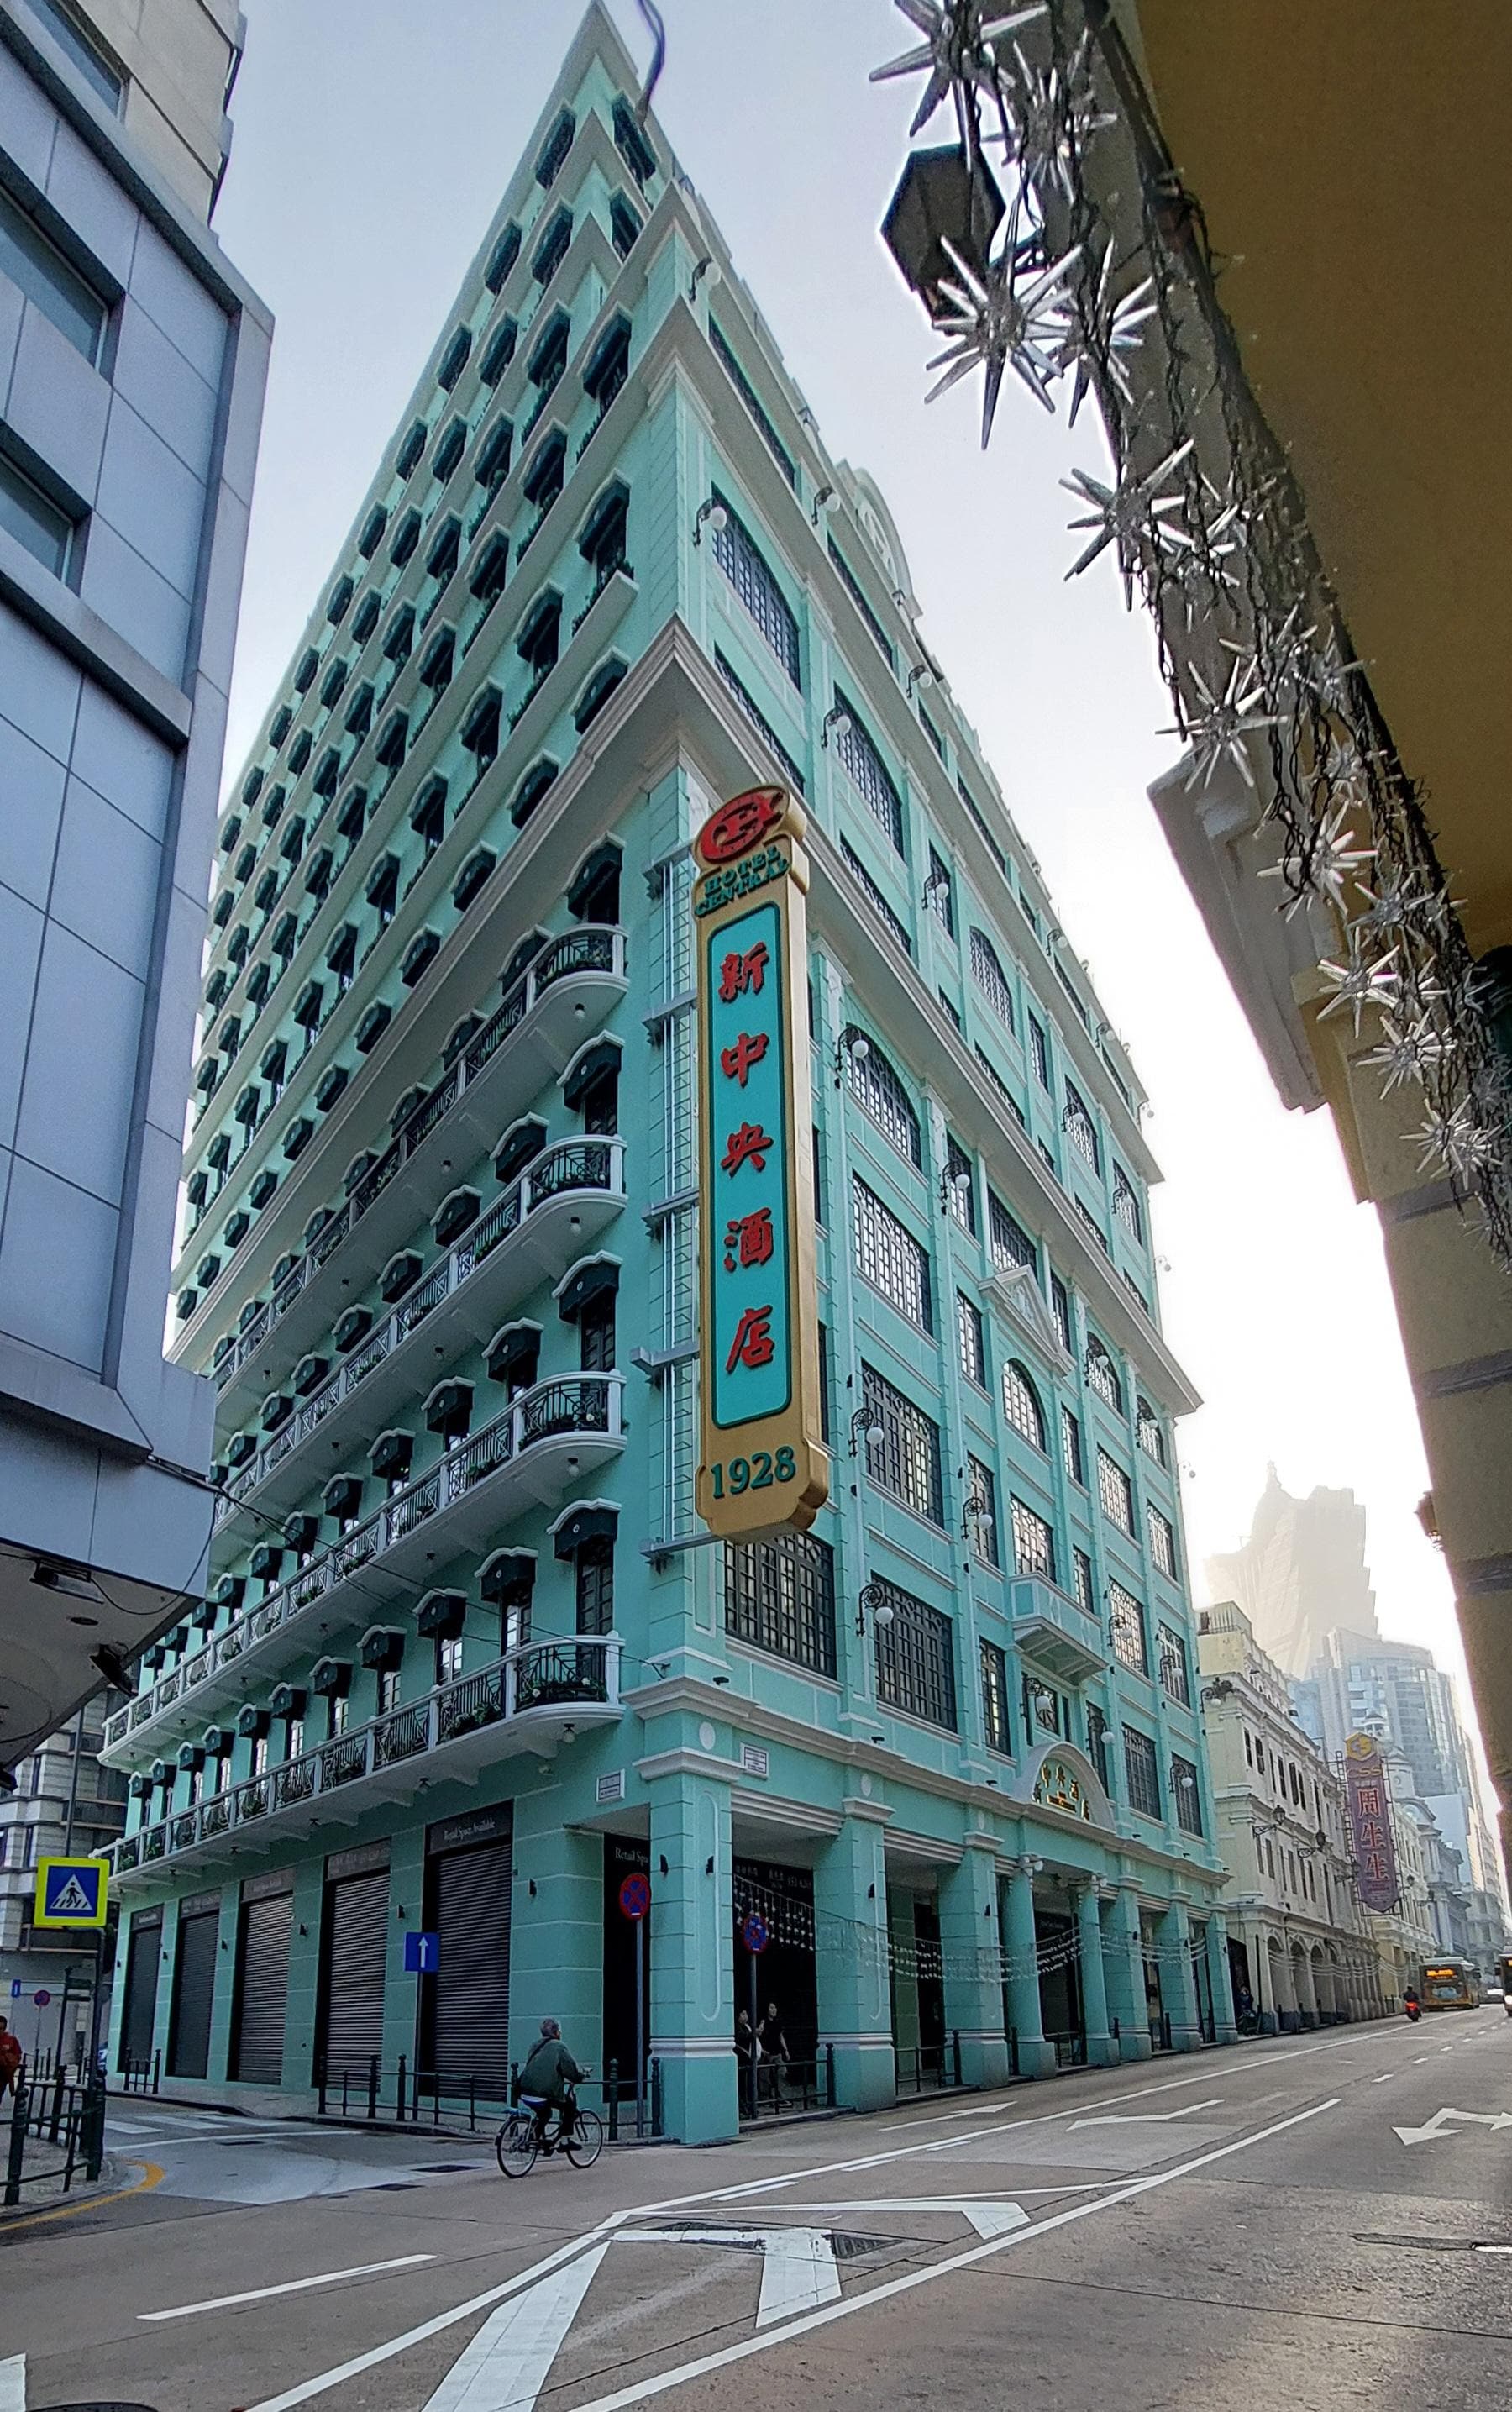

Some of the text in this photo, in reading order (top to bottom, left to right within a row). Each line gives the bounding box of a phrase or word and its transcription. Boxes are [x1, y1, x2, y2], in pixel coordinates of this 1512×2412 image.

[694, 859, 790, 919] CENTRAL
[704, 845, 781, 897] HOTEL
[719, 941, 774, 1374] 新中央酒店
[710, 1444, 797, 1500] 1928
[615, 1847, 635, 1861] Retail
[1357, 1787, 1391, 1883] 周生生
